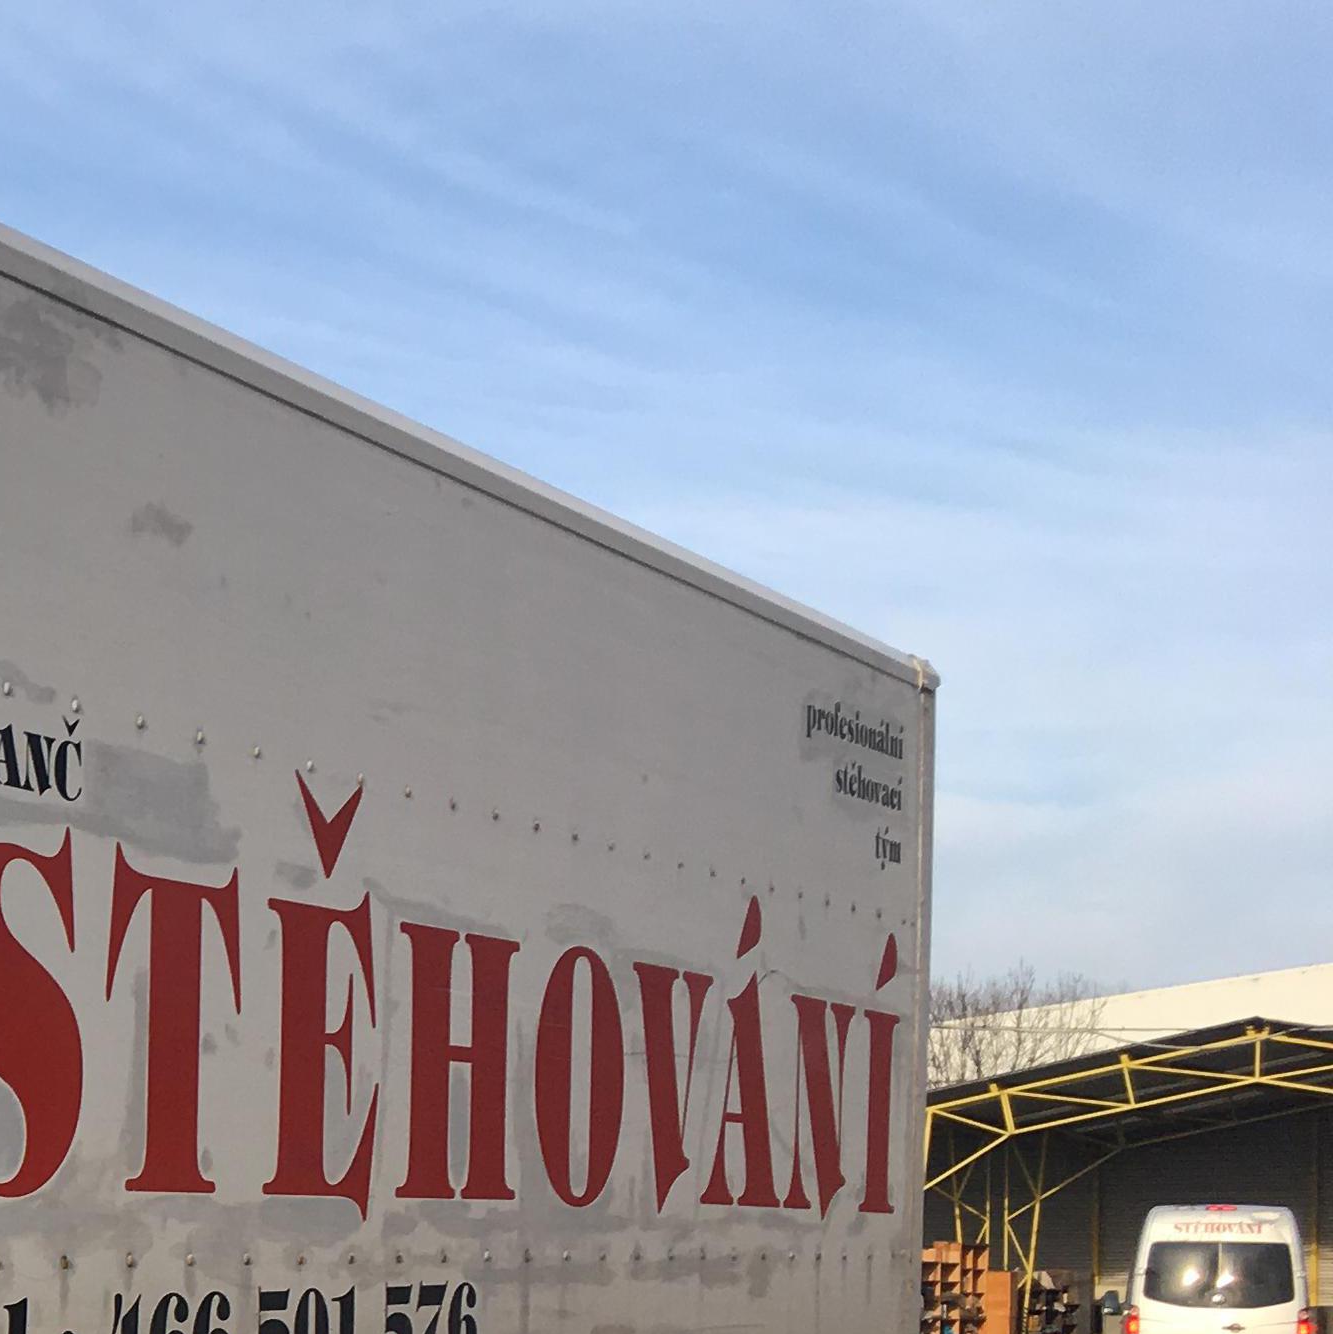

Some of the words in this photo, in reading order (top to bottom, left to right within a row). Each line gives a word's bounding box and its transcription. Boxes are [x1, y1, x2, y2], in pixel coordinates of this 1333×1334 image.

[806, 701, 903, 760] profesionální
[835, 760, 903, 811] stěhovací
[875, 826, 902, 870] tým
